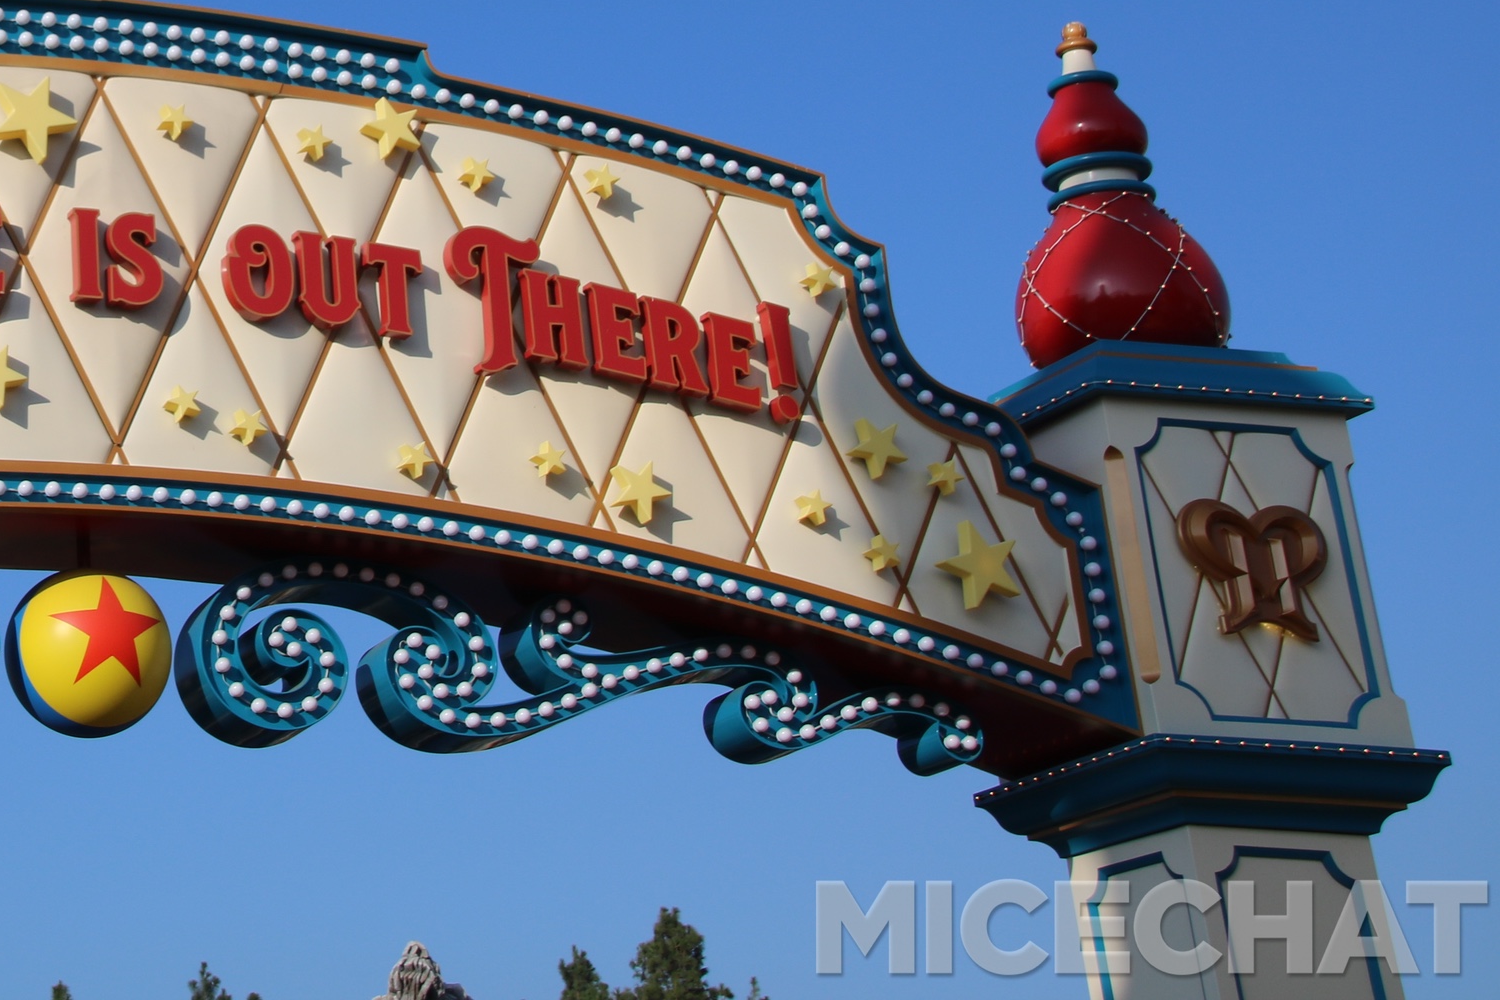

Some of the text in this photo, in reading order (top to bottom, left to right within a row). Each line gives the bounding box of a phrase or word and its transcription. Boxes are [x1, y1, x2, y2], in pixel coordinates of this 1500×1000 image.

[67, 207, 164, 309] IS
[221, 223, 422, 339] OUT
[443, 225, 800, 425] THERE!
